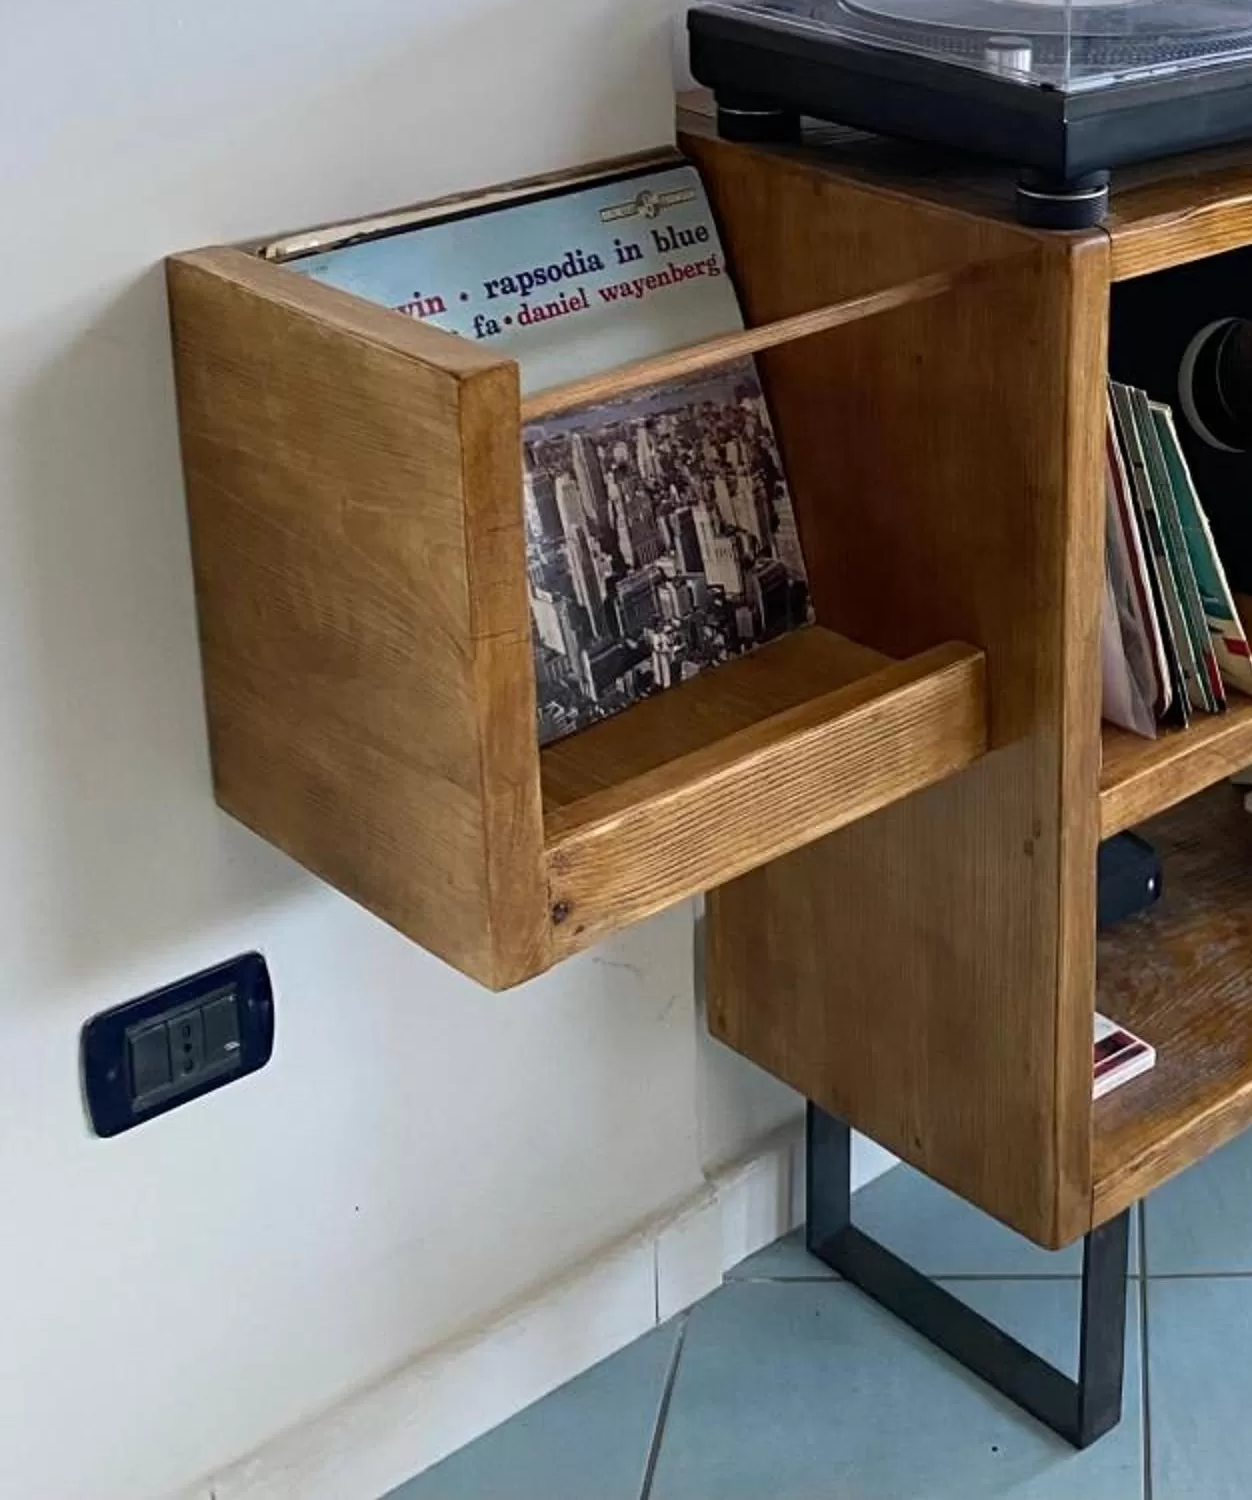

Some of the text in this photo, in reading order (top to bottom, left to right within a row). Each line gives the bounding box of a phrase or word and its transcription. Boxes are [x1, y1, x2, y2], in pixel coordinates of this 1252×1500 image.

[473, 253, 722, 338] fa daniel wayenberg
[483, 249, 605, 300] rapsodia
[614, 238, 644, 265] in
[654, 225, 711, 253] blue
